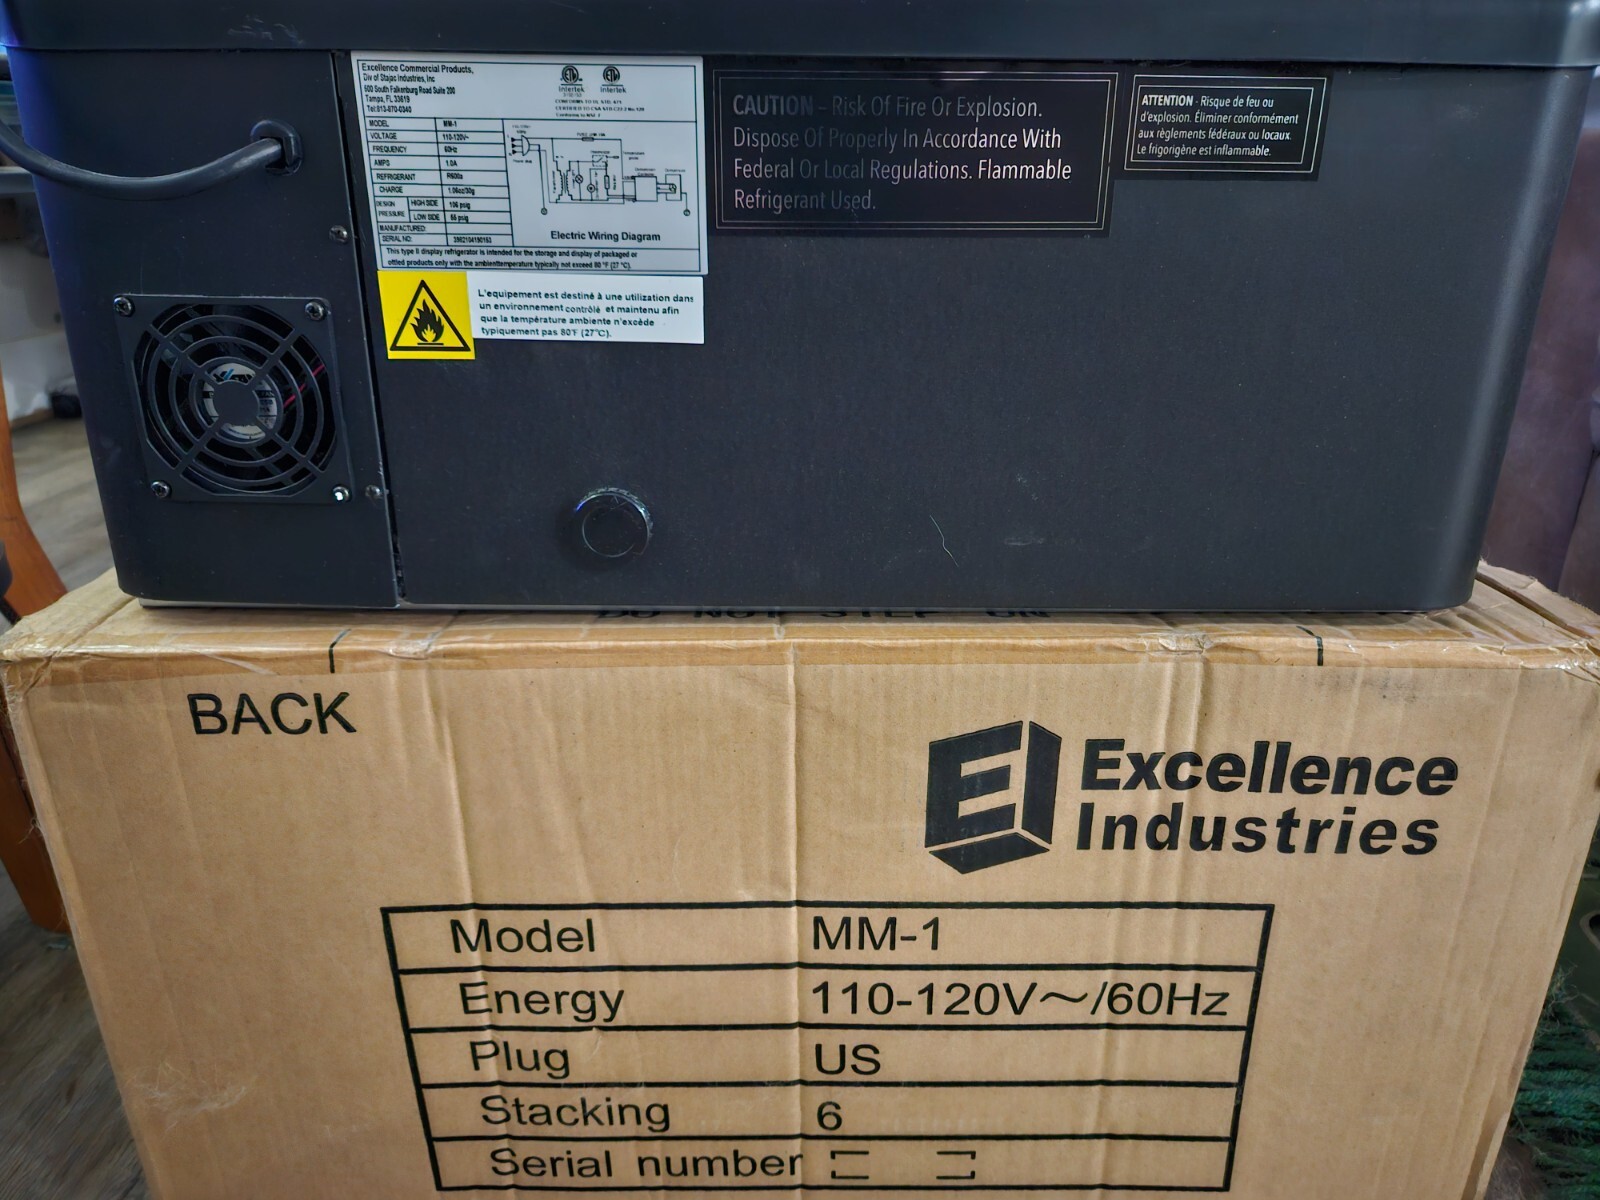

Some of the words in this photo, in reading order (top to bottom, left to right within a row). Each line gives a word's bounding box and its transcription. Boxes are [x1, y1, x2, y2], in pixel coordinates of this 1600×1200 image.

[362, 63, 398, 72] Excellence
[400, 64, 440, 73] Commercial
[441, 65, 474, 74] Products,
[380, 74, 396, 83] Stajac
[398, 75, 426, 83] Industries,
[390, 86, 418, 95] Falkenburg
[365, 95, 385, 103] Tampa,
[1142, 95, 1194, 106] ATTENTION
[1201, 96, 1231, 109] Risque
[1233, 96, 1244, 107] de
[1246, 96, 1260, 107] feu
[1262, 99, 1274, 107] ou
[733, 94, 813, 117] CAUTION
[832, 95, 866, 116] Risk
[871, 95, 891, 117] Of
[896, 96, 927, 117] Fire
[931, 97, 952, 117] Or
[956, 97, 1043, 122] Explosion.
[1140, 111, 1192, 124] d'explosion.
[1195, 109, 1232, 123] Éliminer
[1234, 112, 1298, 124] conformément
[734, 127, 800, 152] Dispose
[804, 127, 824, 148] Of
[828, 127, 898, 154] Properly
[903, 128, 919, 148] In
[922, 128, 1018, 148] Accordance
[1023, 129, 1061, 148] With
[1138, 130, 1154, 138] aux
[1156, 128, 1206, 141] règlements
[1208, 128, 1246, 139] fédéraux
[1248, 132, 1260, 140] ou
[1261, 129, 1292, 140] locaux.
[1137, 144, 1147, 154] Le
[1148, 144, 1197, 158] frigorigène
[1199, 146, 1212, 155] est
[1214, 144, 1272, 156] inflammable.
[735, 158, 795, 179] Federal
[800, 159, 820, 179] Or
[824, 159, 866, 179] Local
[870, 160, 973, 184] Regulations.
[978, 160, 1072, 180] Flammable
[460, 202, 470, 210] psig
[735, 189, 827, 214] Refrigerant
[831, 190, 877, 209] Used.
[551, 231, 586, 240] Electric
[588, 231, 619, 242] Wiring
[621, 232, 660, 243] Diagram
[421, 248, 442, 256] display
[534, 250, 556, 258] storage
[602, 251, 629, 259] packaged
[534, 261, 559, 269] typically
[478, 289, 542, 300] L'equipement
[545, 292, 558, 300] est
[561, 291, 595, 301] destiné
[597, 291, 603, 301] à
[605, 293, 622, 301] une
[625, 293, 671, 302] utilization
[673, 294, 694, 302] dans
[493, 302, 564, 312] environnement
[565, 305, 601, 313] contrôlé
[616, 306, 660, 314] maintenu
[662, 306, 679, 314] afin
[481, 316, 497, 325] que
[500, 315, 508, 323] la
[510, 315, 567, 327] température
[569, 317, 611, 326] ambiente
[613, 318, 655, 327] n'excède
[481, 327, 539, 337] typiquement
[541, 329, 558, 337] pas
[186, 691, 358, 735] BACK
[1079, 738, 1459, 795] Excellence
[1075, 801, 1440, 855] Industries
[449, 918, 597, 954] Model
[811, 918, 941, 951] MM-1
[459, 981, 625, 1022] Energy
[469, 1040, 571, 1079] Plug
[814, 1042, 882, 1075] US
[480, 1095, 671, 1132] Stacking
[815, 1102, 844, 1131] 6
[489, 1148, 612, 1179] Serial
[635, 1146, 803, 1179] number
